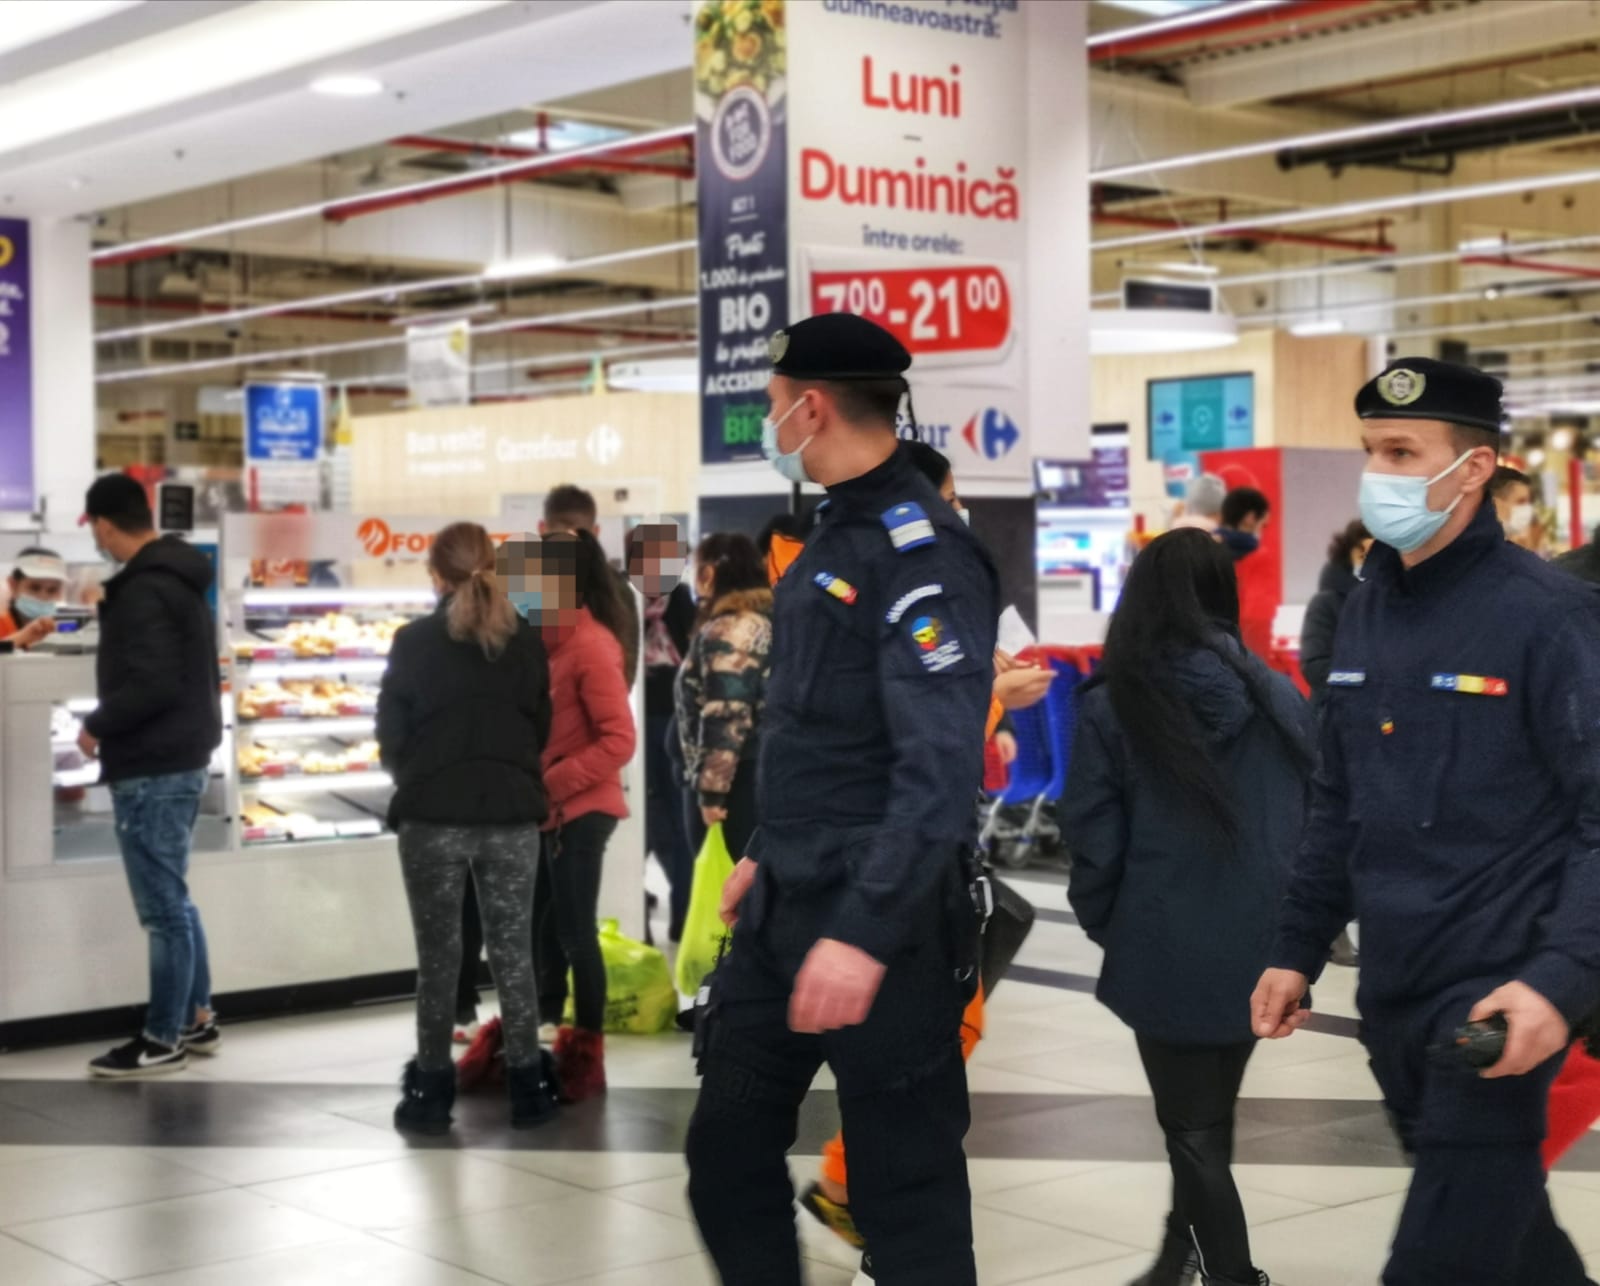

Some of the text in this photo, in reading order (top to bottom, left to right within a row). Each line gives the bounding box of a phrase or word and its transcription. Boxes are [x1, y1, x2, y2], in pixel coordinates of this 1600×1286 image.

[862, 56, 961, 118] Luni
[800, 148, 1019, 221] Duminică
[863, 224, 964, 254] între orele:
[719, 293, 770, 334] BIO
